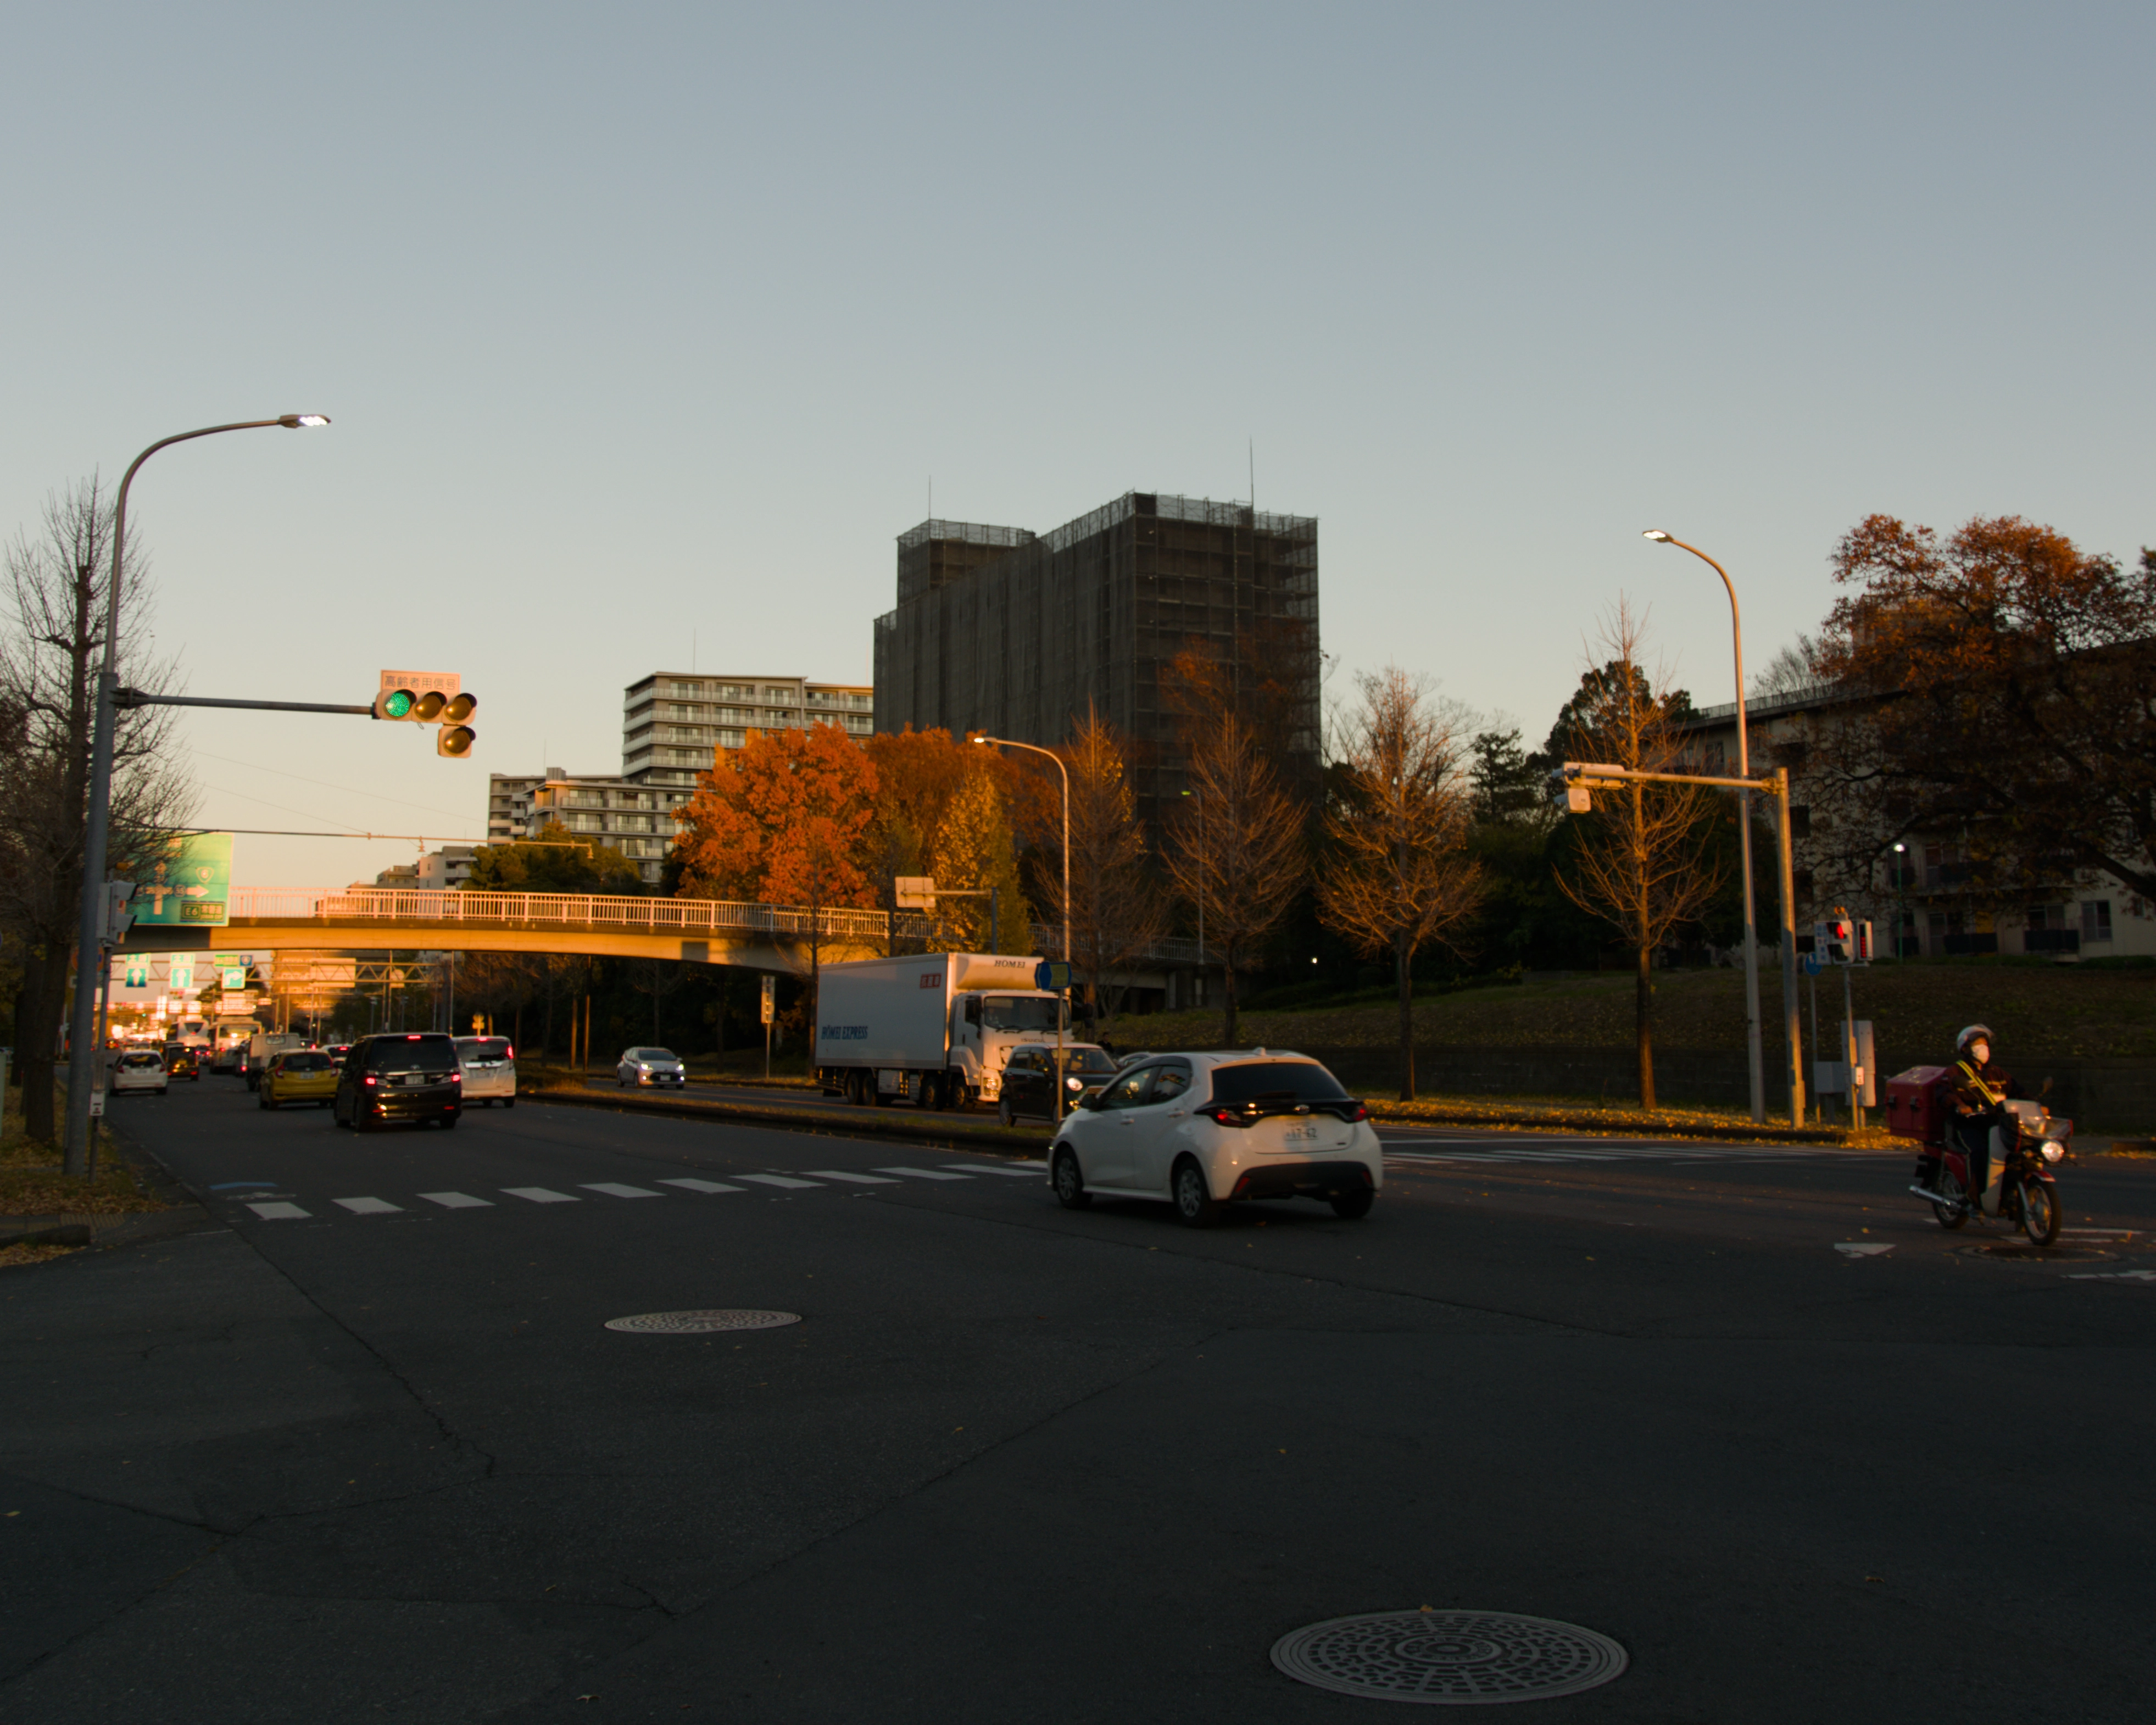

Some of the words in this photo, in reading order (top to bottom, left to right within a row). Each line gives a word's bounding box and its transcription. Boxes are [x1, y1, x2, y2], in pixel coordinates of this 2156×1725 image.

[385, 675, 456, 690] 高齢者用信号
[185, 907, 198, 916] E6
[842, 1026, 868, 1040] EXPRESS
